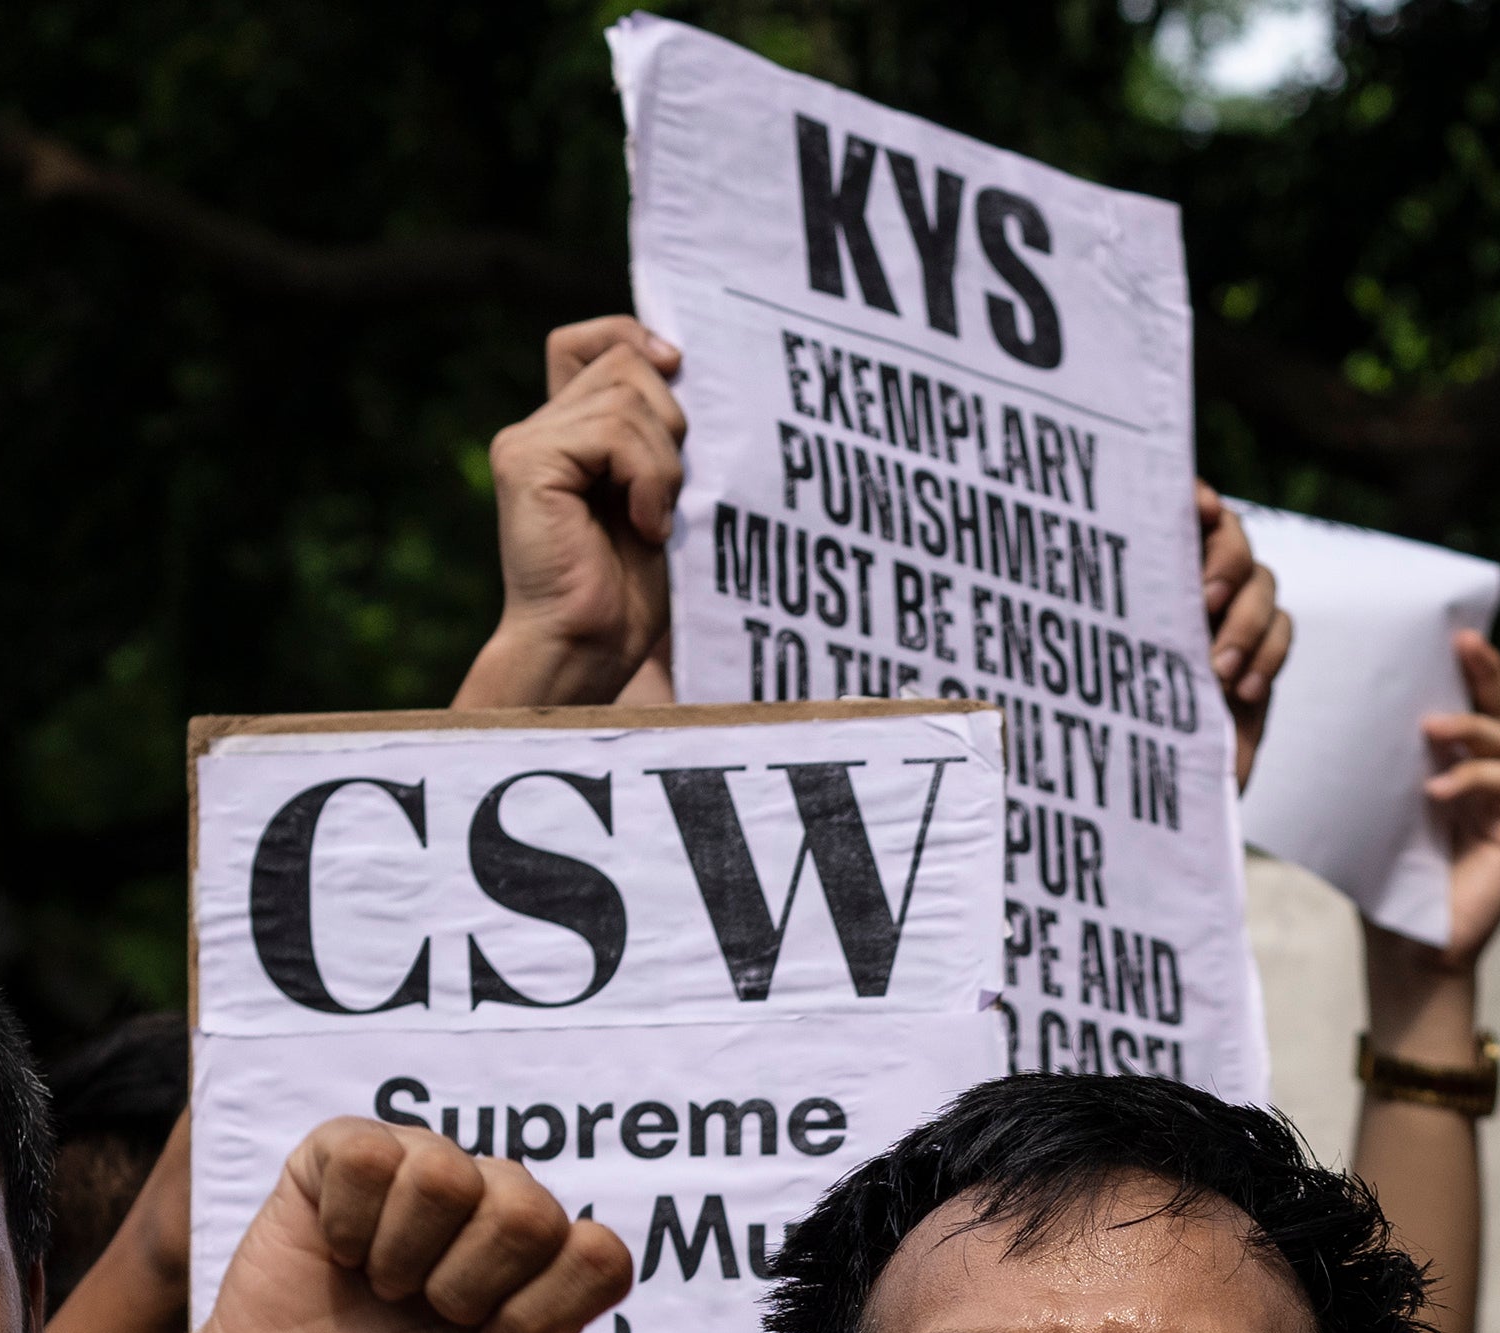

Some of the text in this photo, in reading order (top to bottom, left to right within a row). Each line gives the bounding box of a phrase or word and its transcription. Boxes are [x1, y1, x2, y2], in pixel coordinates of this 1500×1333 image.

[795, 112, 1065, 371] KYS
[777, 424, 1128, 618] PUNISHMENT
[781, 330, 1098, 510] EXEMPLARY
[714, 505, 1198, 735] MUST BE ENSURED
[745, 617, 811, 700] TO
[1128, 733, 1180, 832] IN
[250, 757, 968, 1016] CSW
[1080, 918, 1183, 1025] AND
